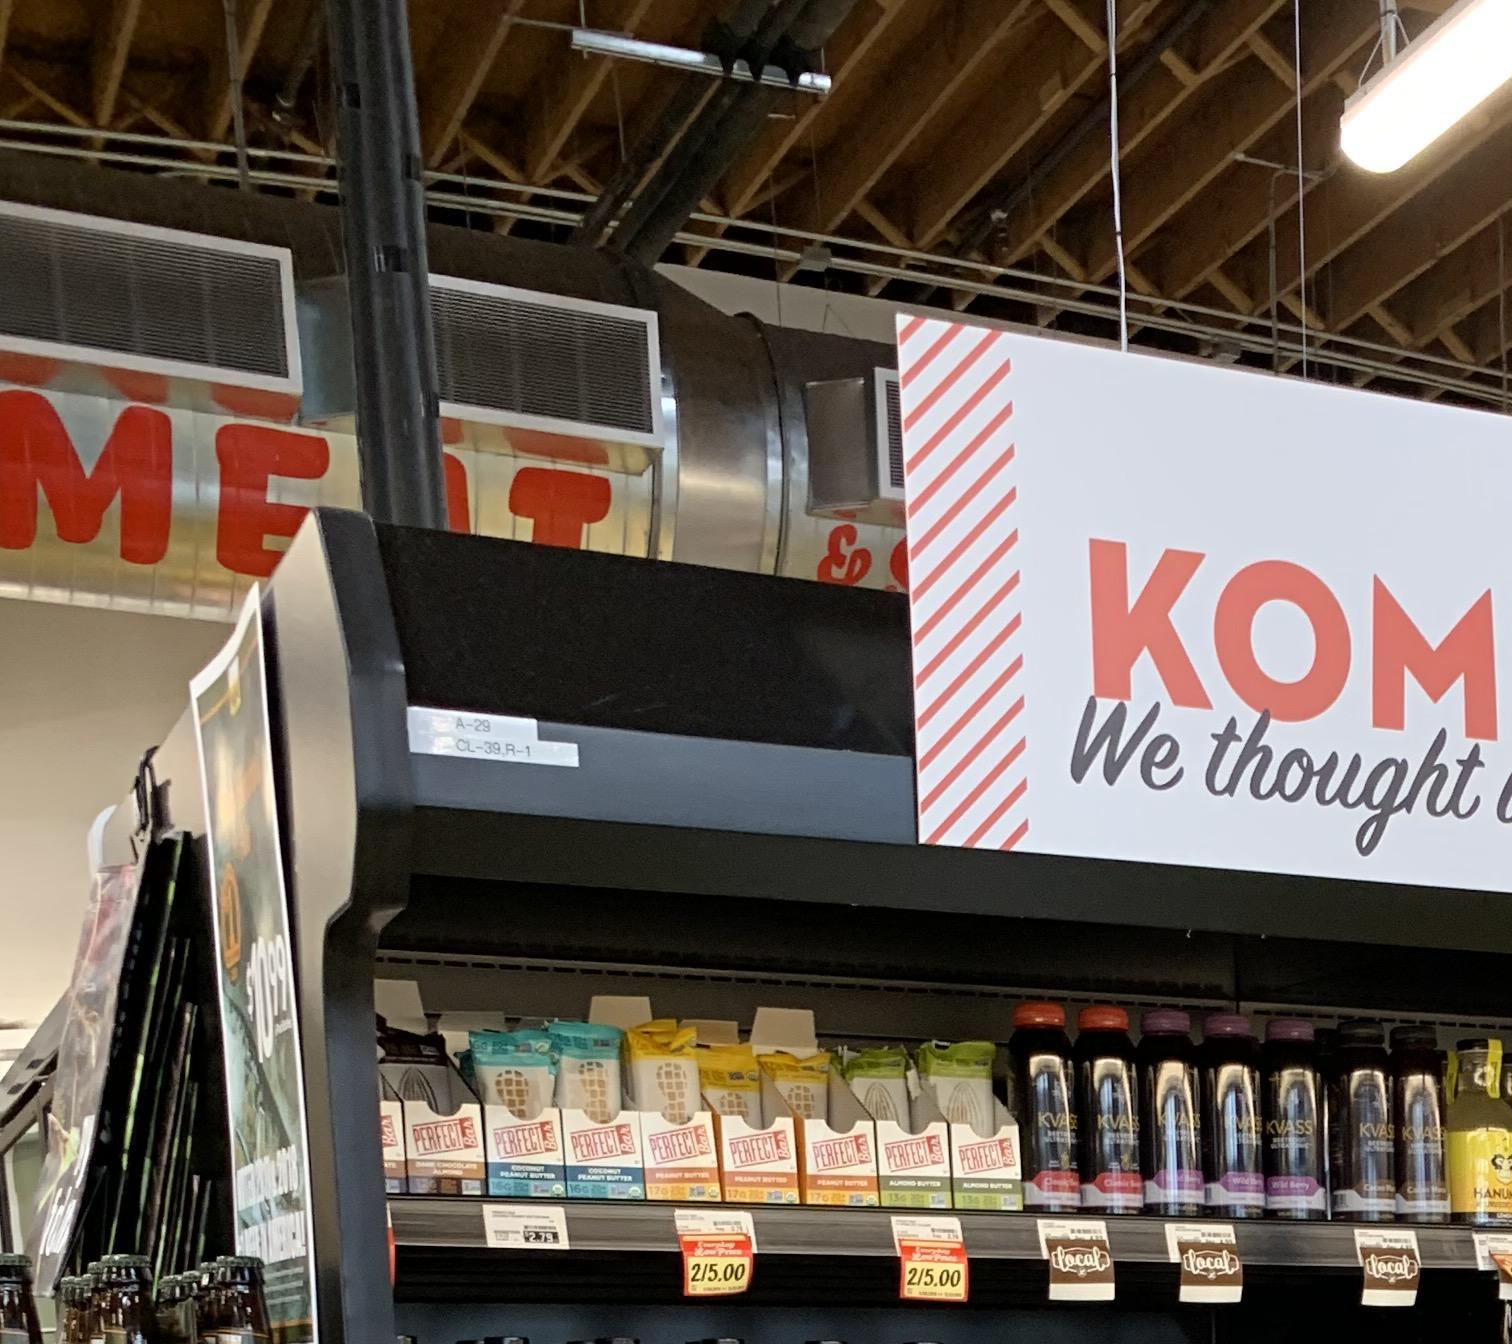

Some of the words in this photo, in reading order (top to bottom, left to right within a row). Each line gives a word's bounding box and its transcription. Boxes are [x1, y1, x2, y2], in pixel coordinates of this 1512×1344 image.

[0, 388, 612, 578] MET
[455, 718, 492, 733] A-29
[1070, 695, 1184, 792] We
[1204, 709, 1484, 857] thought
[413, 1120, 463, 1156] PERFECT
[1266, 1120, 1313, 1135] KVASS
[494, 1124, 545, 1158] PERFECT
[691, 1264, 745, 1282] 2/5.00
[908, 1269, 961, 1287] 2/5.00
